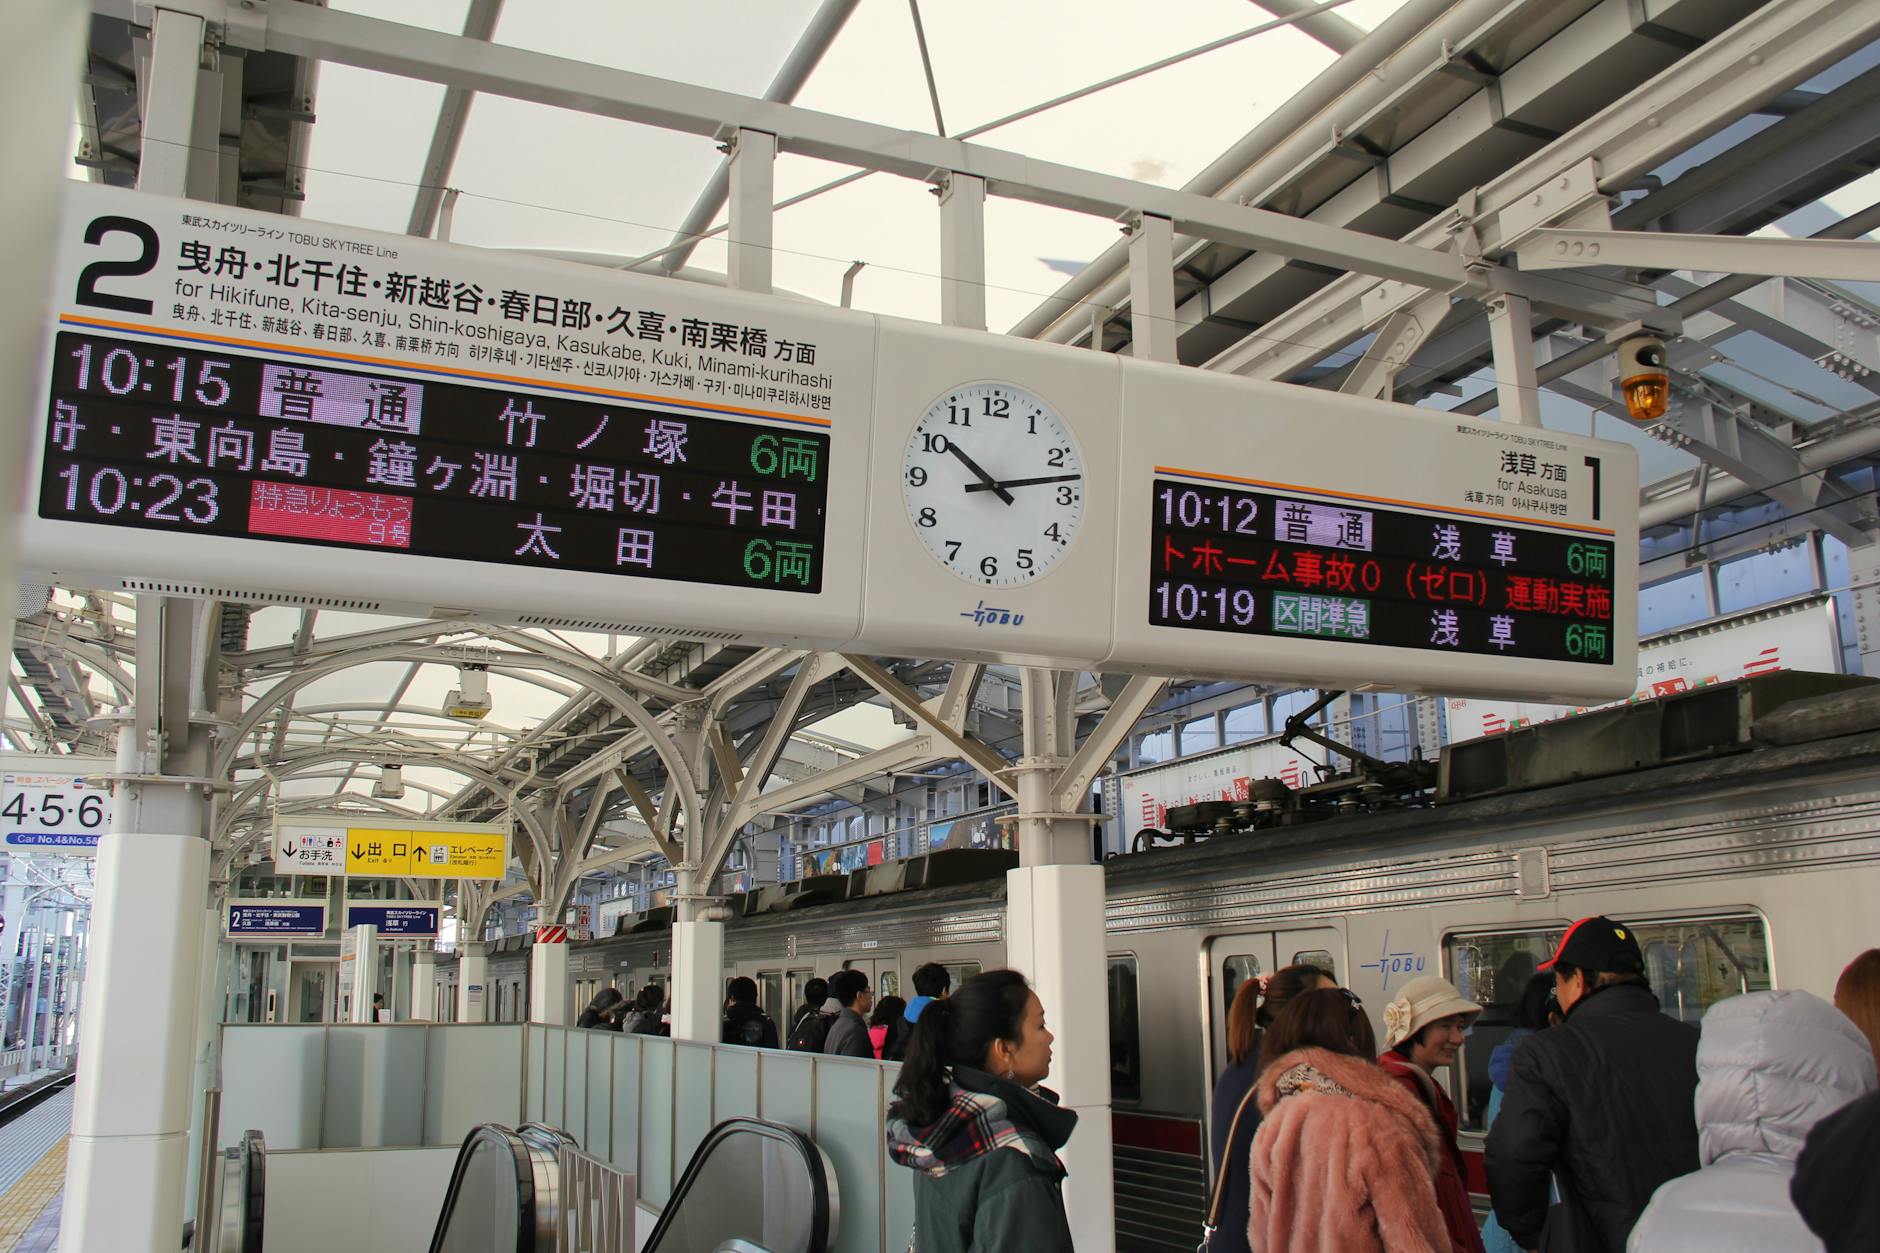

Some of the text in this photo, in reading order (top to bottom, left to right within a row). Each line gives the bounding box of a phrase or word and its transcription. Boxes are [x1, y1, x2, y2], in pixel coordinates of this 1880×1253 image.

[182, 214, 399, 260] 東武スカイツリーライン TOBU SKYTREE Line
[76, 215, 159, 315] 2
[175, 278, 833, 390] for Hikifune, Kita-senju, Shin-koshigaya, Kasukabe, Kuki, Minami-kurihashi
[774, 340, 817, 366] 方面
[71, 343, 231, 407] 10:15
[273, 369, 410, 433] 普通
[750, 433, 820, 482] 6両
[948, 405, 972, 427] 11
[982, 397, 1010, 419] 12
[1027, 415, 1037, 434] 1
[922, 433, 949, 453] 10
[1510, 434, 1527, 445] TOBU
[1528, 438, 1555, 450] SKYTREE
[1047, 448, 1064, 467] 2
[1500, 450, 1567, 482] 浅草 方面
[909, 467, 928, 487] 9
[1056, 486, 1073, 505] 3
[1497, 477, 1567, 499] for Asakusa
[1584, 455, 1600, 521] 1
[59, 463, 219, 524] 10:23
[743, 538, 814, 586] 6両
[918, 507, 937, 527] 8
[1044, 522, 1062, 541] 4
[1160, 488, 1258, 535] 10:12
[1282, 503, 1366, 549] 普通
[1567, 543, 1607, 579] 6両
[945, 540, 962, 561] 7
[1016, 549, 1033, 569] 5
[980, 556, 998, 577] 6
[960, 608, 1024, 627] TOBU
[1156, 581, 1256, 626] 10:19
[1275, 593, 1370, 638] 区間準急
[1565, 623, 1607, 659] 6両
[17, 834, 35, 843] Car
[299, 849, 333, 861] お手洗
[368, 842, 406, 857] 出口
[450, 845, 503, 855] エレベーター
[232, 911, 241, 927] 2
[429, 913, 434, 929] 1
